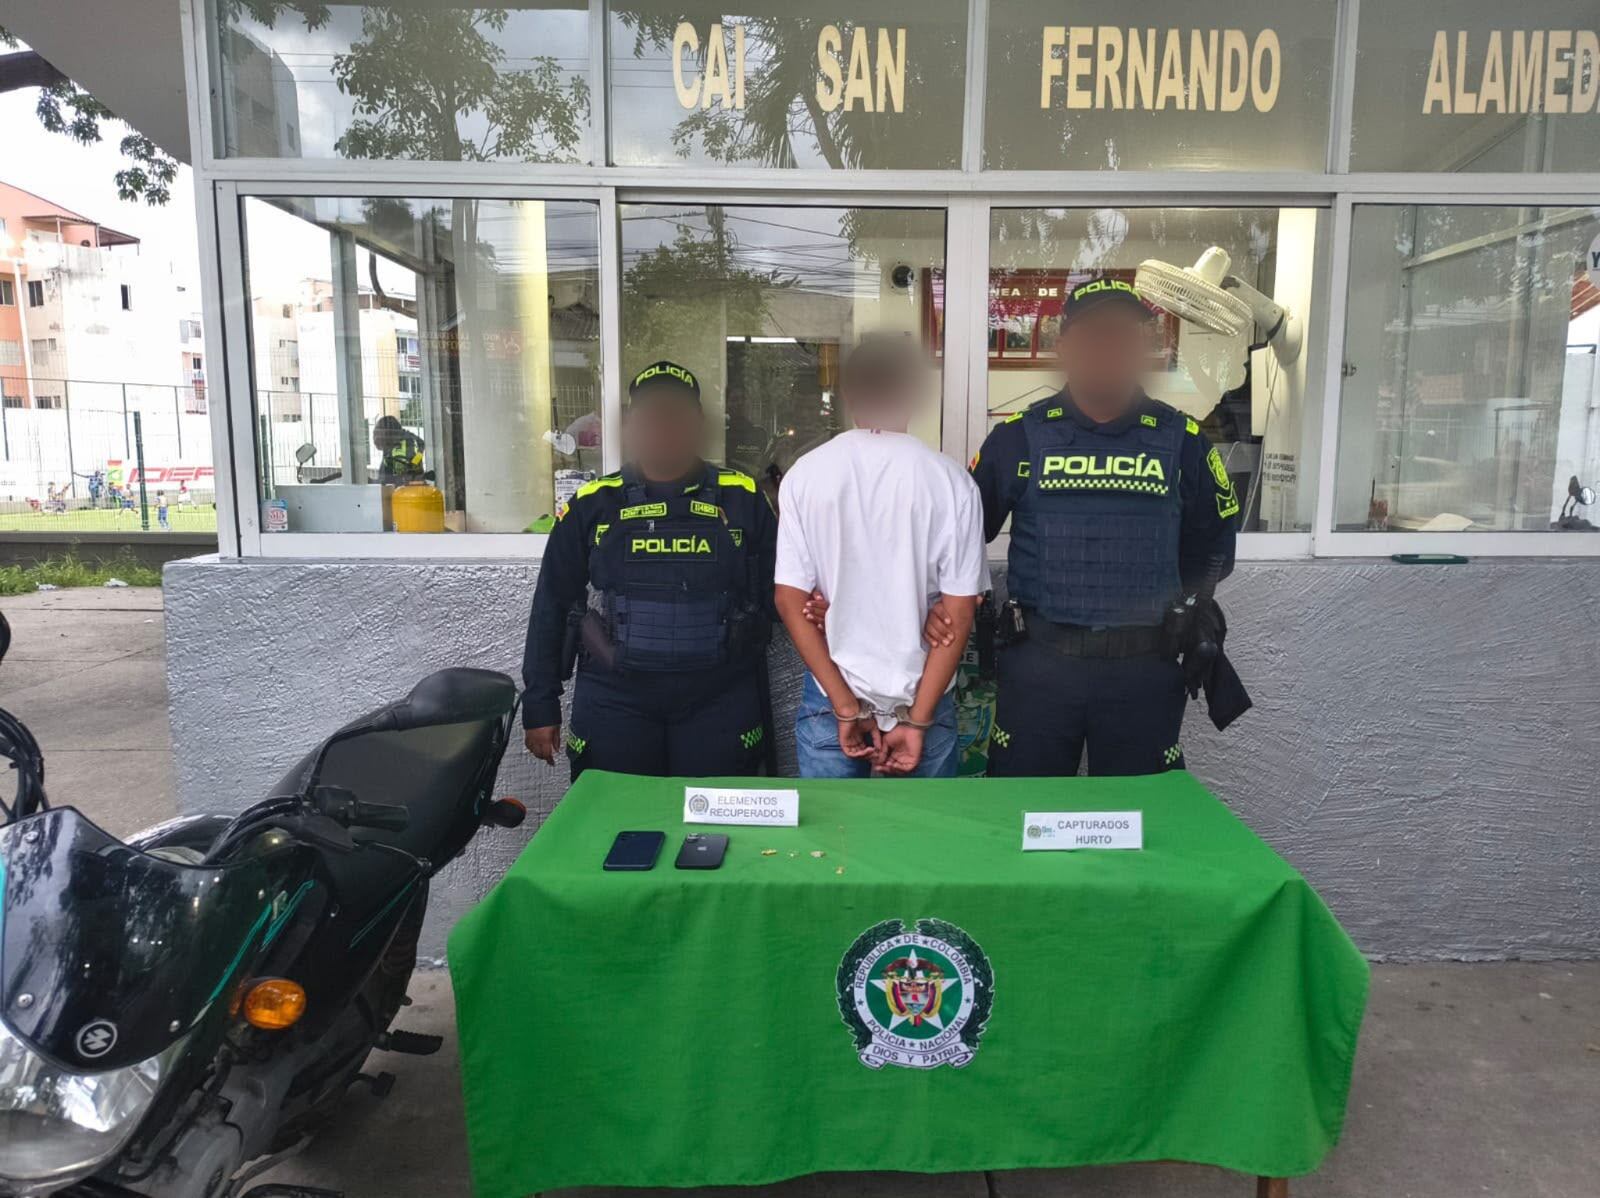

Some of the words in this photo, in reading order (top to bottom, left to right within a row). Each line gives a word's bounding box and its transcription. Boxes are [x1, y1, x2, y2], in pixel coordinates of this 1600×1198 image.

[672, 22, 745, 110] CAI
[815, 25, 906, 113] SAN
[1040, 26, 1281, 113] FERNANDO
[1422, 30, 1600, 114] ALAMED
[1038, 287, 1058, 297] DE
[1043, 452, 1165, 481] POLICÍA
[632, 535, 711, 553] POLICÍA
[717, 796, 778, 806] ELEMENTOS
[709, 807, 785, 818] RECUPERADOS
[1057, 820, 1130, 830] CAPTURADOS
[1075, 835, 1113, 845] HURTO
[855, 939, 896, 989] REPUBLICA
[903, 934, 919, 944] DE
[929, 939, 973, 985] COLOMBIA
[866, 1018, 906, 1048] POLICIA
[919, 1015, 968, 1051] NACIONAL
[872, 1045, 899, 1061] DIOS
[907, 1055, 915, 1063] Y
[922, 1044, 962, 1064] PATRIA
